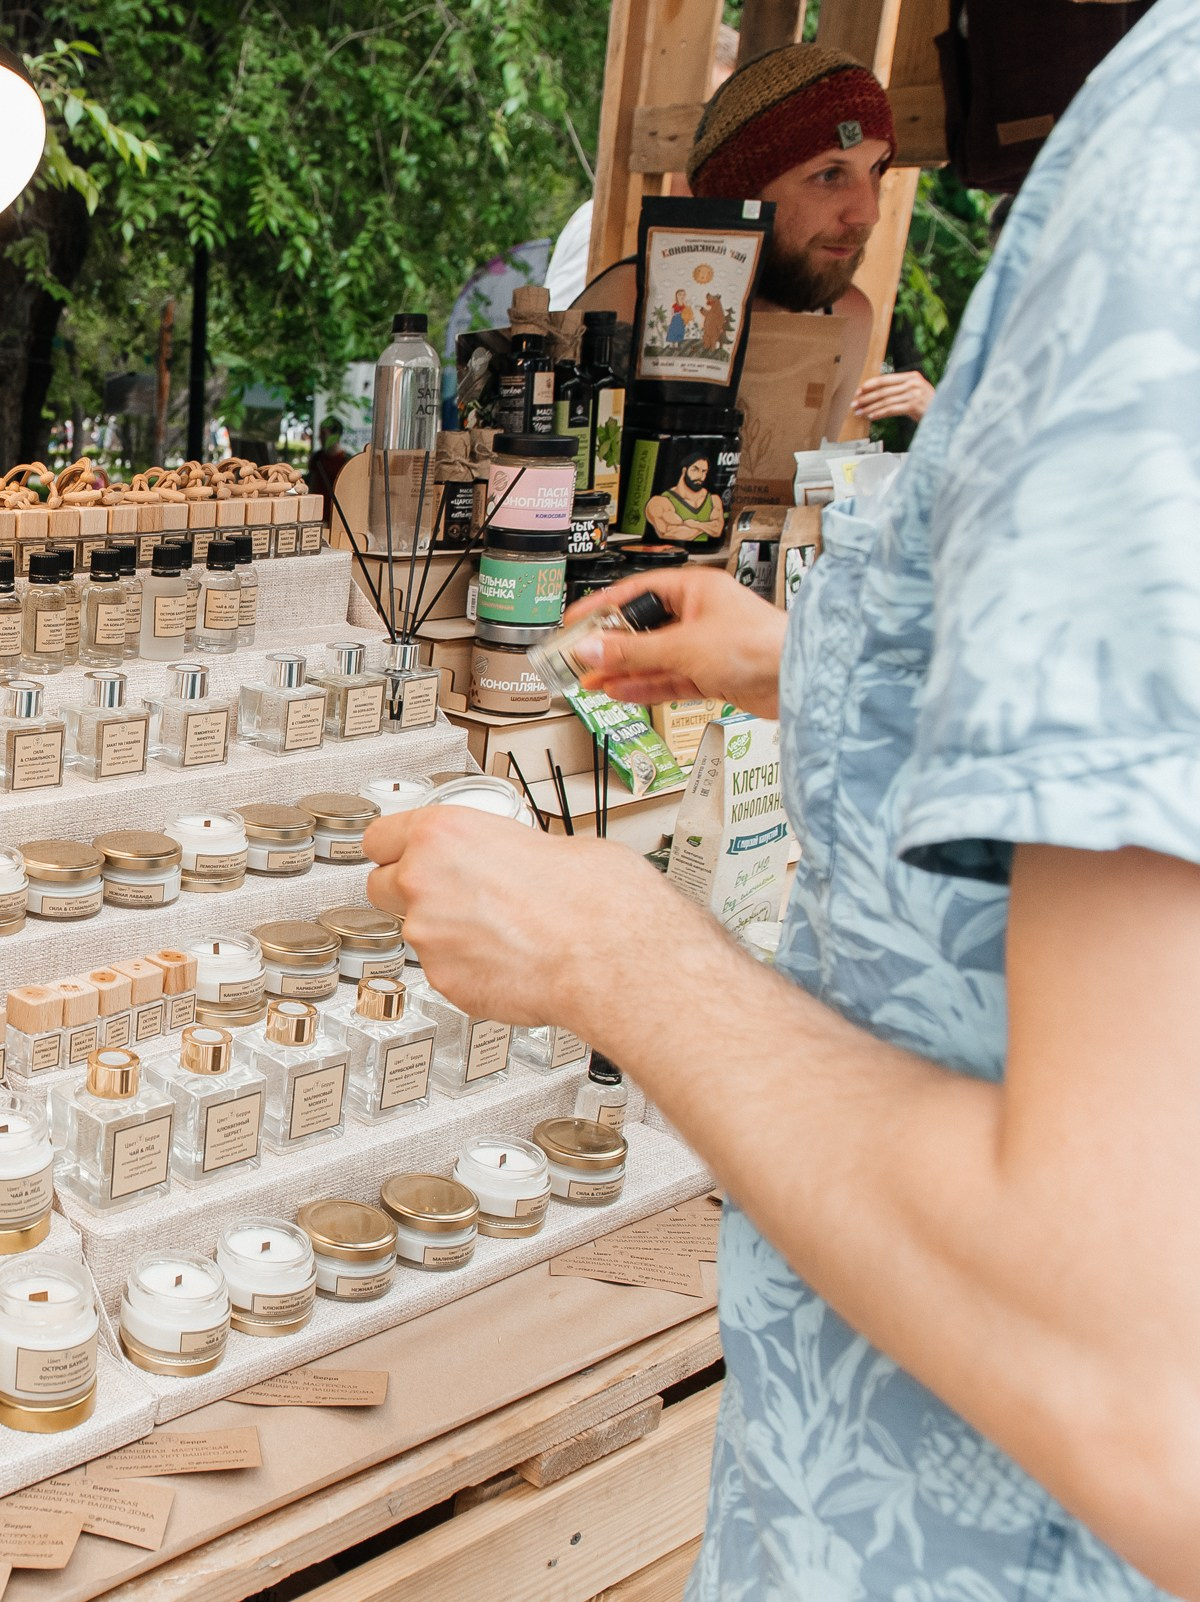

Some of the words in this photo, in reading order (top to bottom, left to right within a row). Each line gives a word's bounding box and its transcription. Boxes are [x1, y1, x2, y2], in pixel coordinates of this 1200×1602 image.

[538, 488, 569, 497] ПАСТА
[568, 542, 593, 553] ПЛЯ
[25, 754, 56, 762] СТАБИЛЬНОСТЬ
[497, 1034, 508, 1042] ЗАКАТ
[389, 1063, 414, 1075] КАРИБСКИЙ
[415, 1061, 427, 1069] БРИЗ
[304, 1089, 333, 1102] МАЛИНОВЫЙ
[308, 1098, 328, 1107] МОХИТО
[216, 1115, 228, 1124] Цвет
[216, 1118, 250, 1133] КЛЮКВЕННЫЙ
[224, 1128, 242, 1138] ЩЕРБЕТ
[124, 1141, 136, 1149] Цвет
[129, 1148, 139, 1156] ЧАЙ
[144, 1144, 155, 1152] ЛЁД
[10, 1191, 22, 1199] ЧАЙ
[30, 1186, 41, 1196] ЛЁД
[42, 1364, 67, 1372] ОСТРОВ
[92, 1485, 120, 1493] Берри
